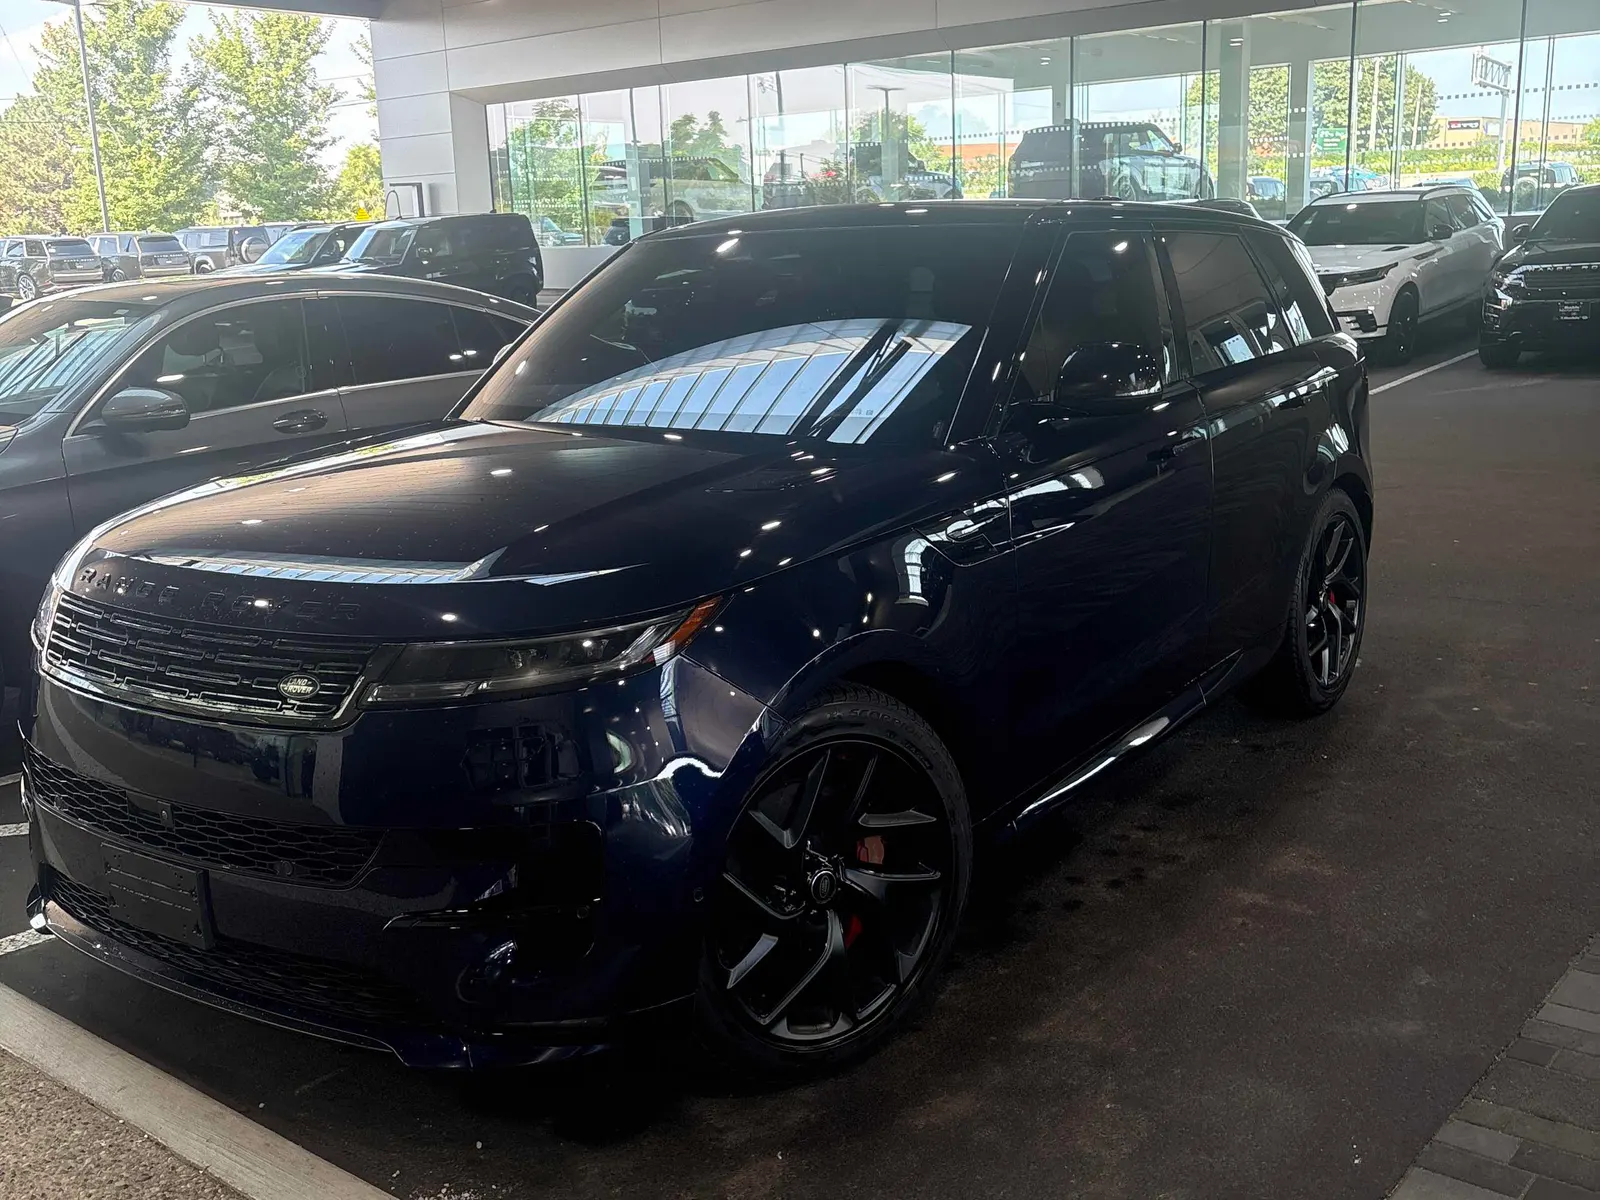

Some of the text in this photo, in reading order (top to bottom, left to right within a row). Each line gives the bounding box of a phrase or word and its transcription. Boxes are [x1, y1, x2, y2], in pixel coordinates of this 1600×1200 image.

[79, 568, 362, 621] RANGE ROVER
[287, 678, 309, 686] LAND
[285, 685, 313, 694] ROVER
